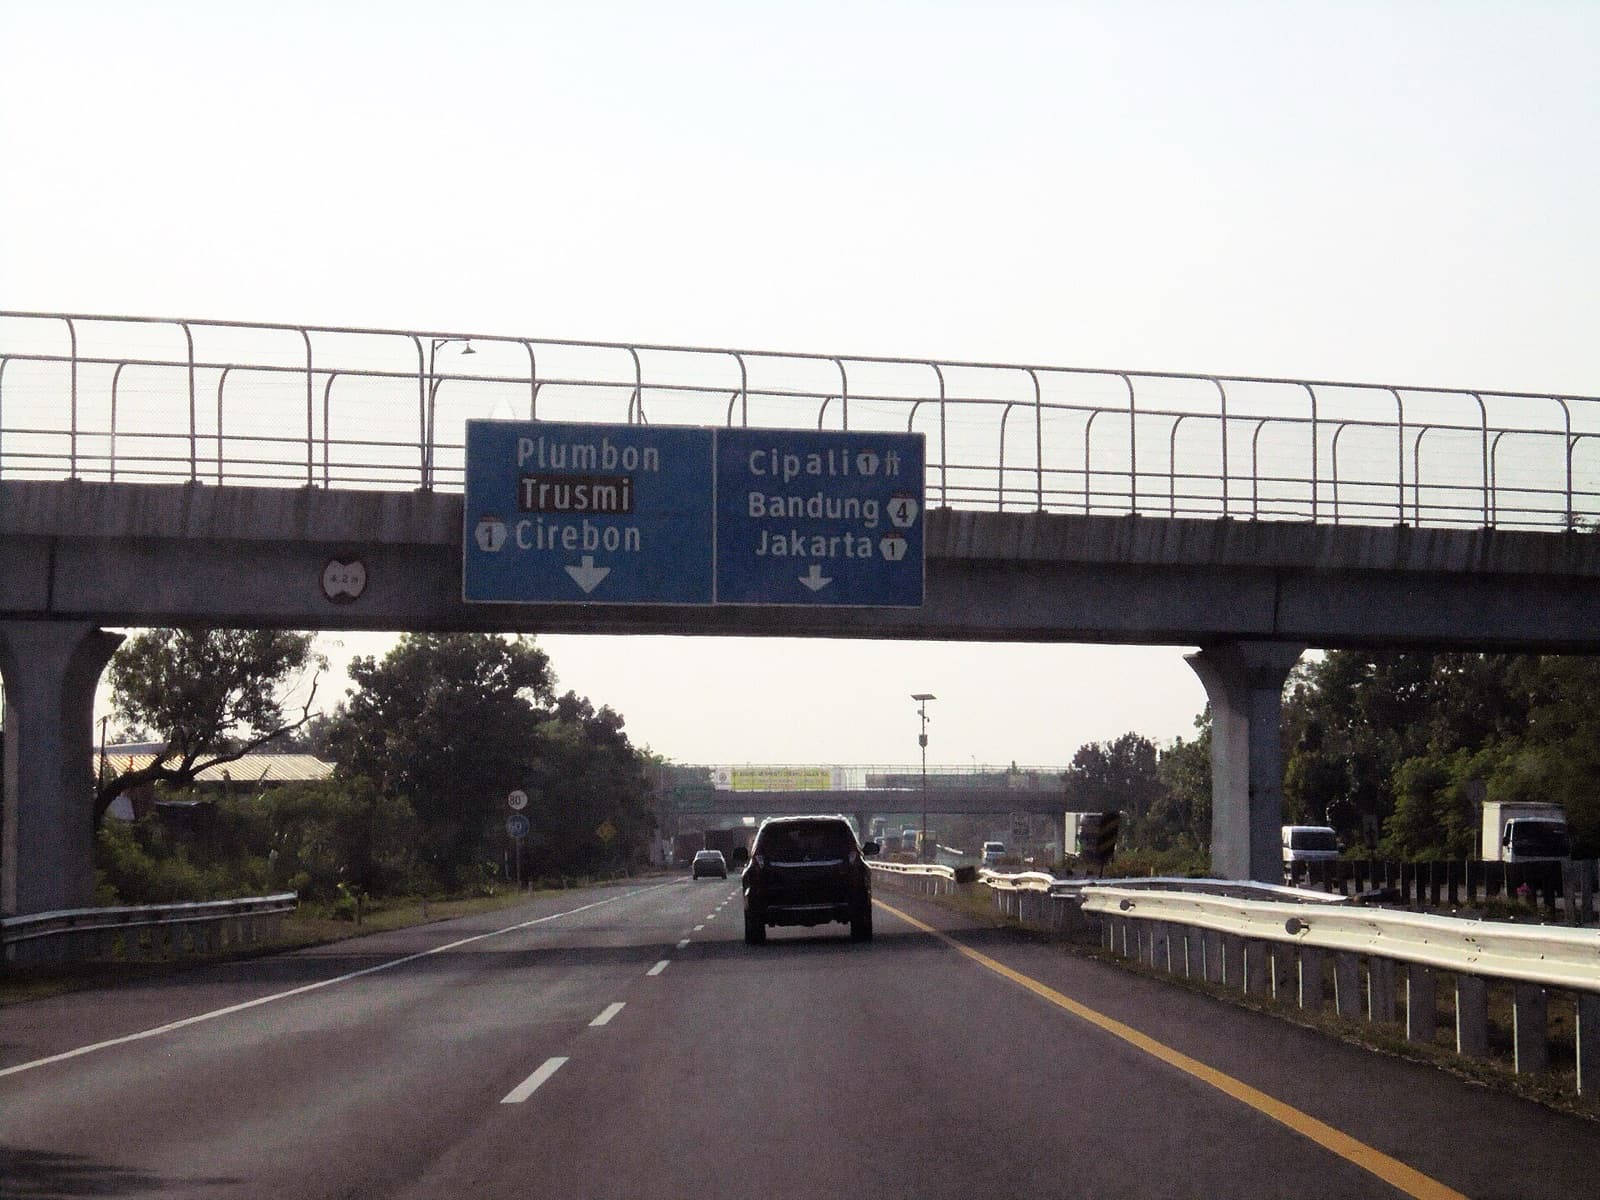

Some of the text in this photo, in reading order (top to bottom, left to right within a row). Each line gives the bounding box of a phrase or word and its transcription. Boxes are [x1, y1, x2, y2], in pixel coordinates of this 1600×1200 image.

[517, 436, 660, 472] Plumbon
[750, 449, 849, 482] Cipali
[522, 478, 630, 511] Trusmi
[749, 491, 907, 528] Bandung 4
[484, 518, 641, 552] 1 Cirebon
[755, 529, 873, 558] Jakarta
